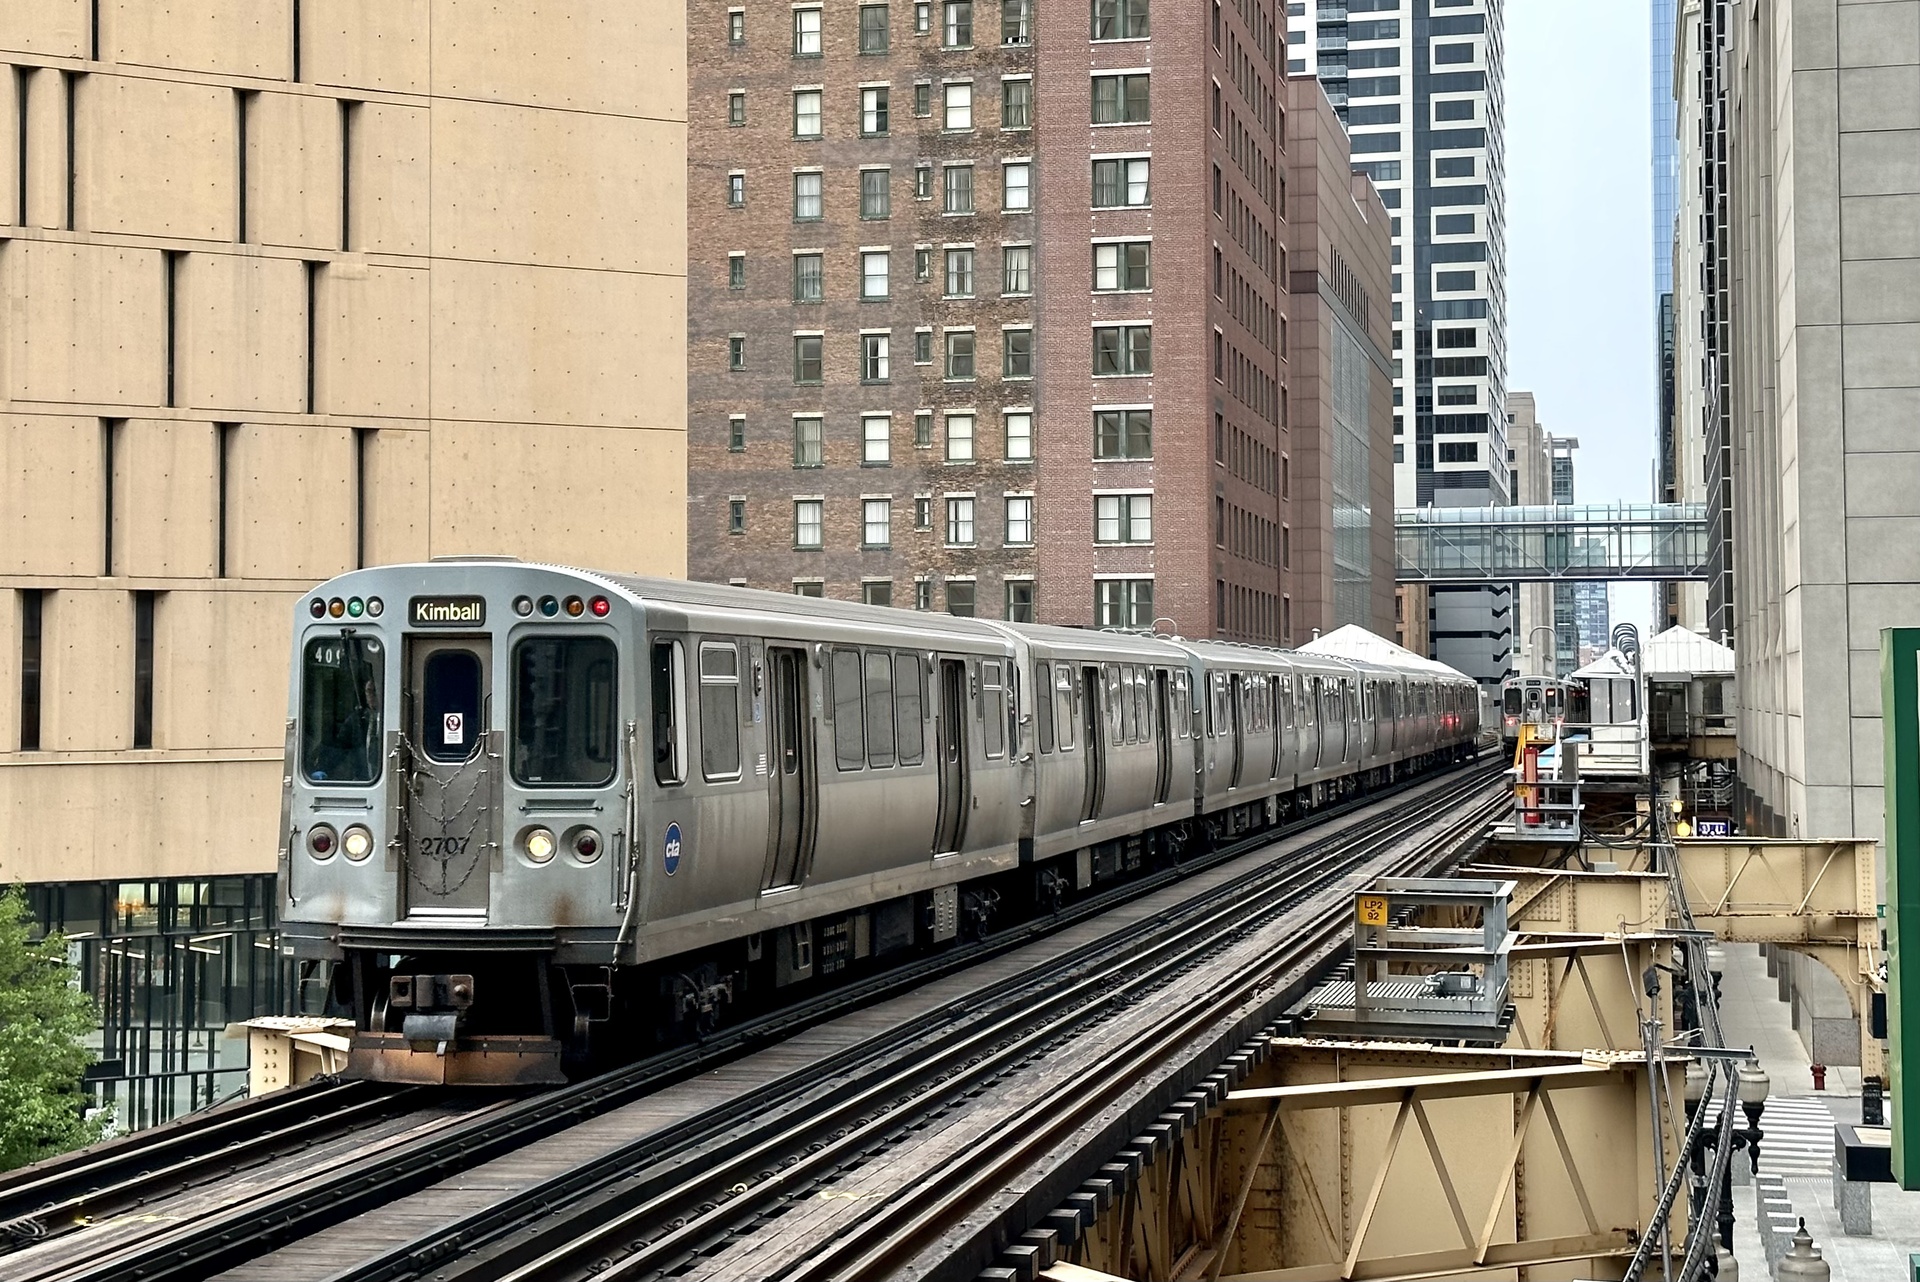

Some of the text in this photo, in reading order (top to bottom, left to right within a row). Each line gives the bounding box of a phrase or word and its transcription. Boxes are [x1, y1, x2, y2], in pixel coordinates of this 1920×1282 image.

[416, 602, 481, 621] Kimball
[420, 836, 471, 855] 2707
[1364, 900, 1384, 910] LP2
[1367, 911, 1380, 921] 92
